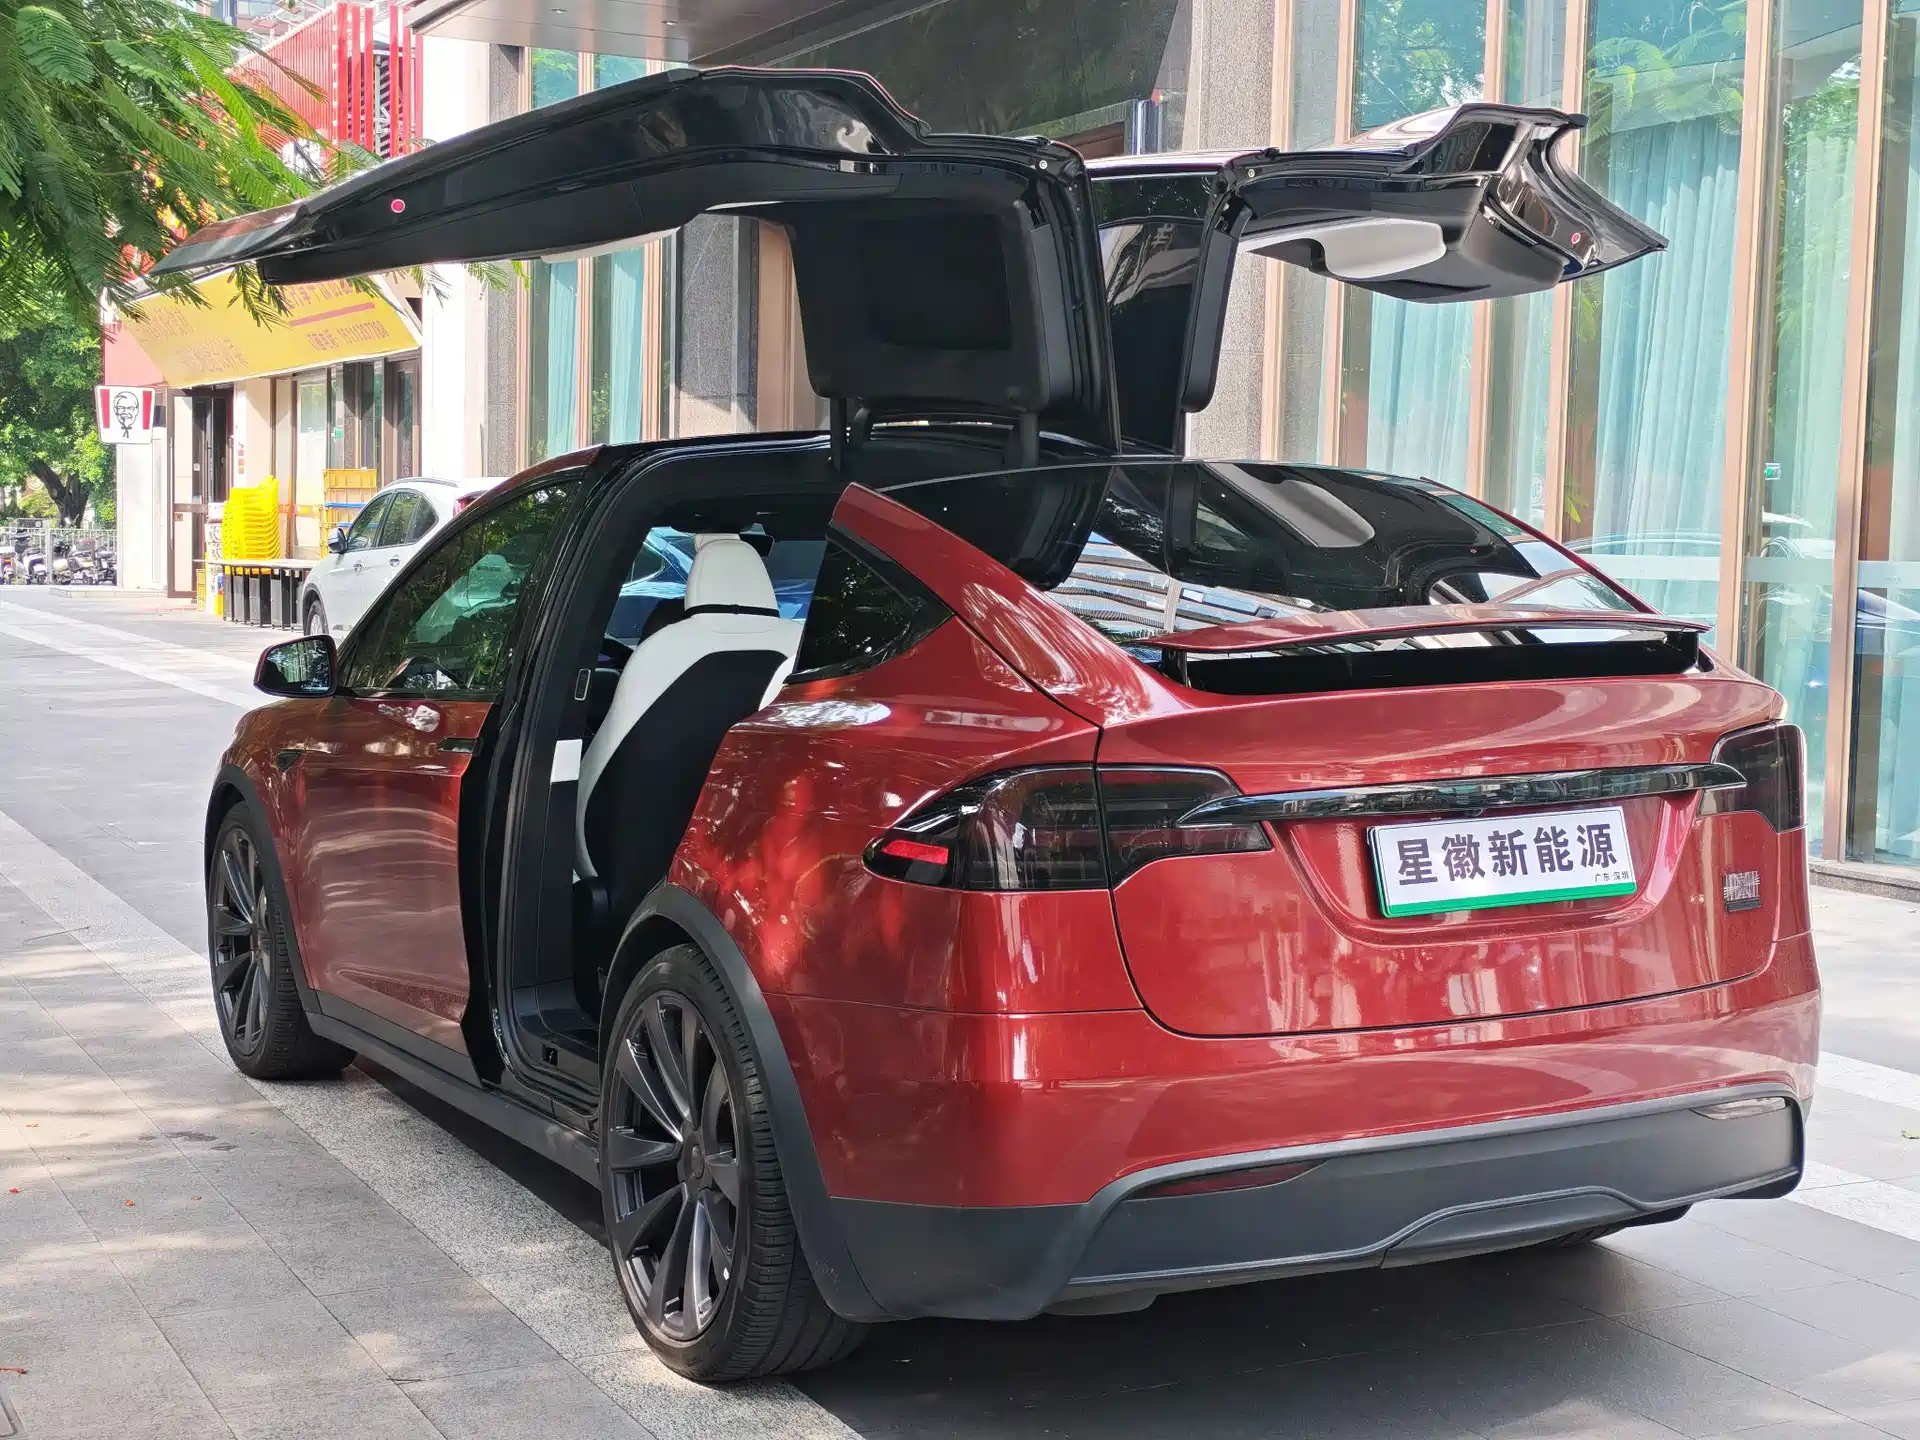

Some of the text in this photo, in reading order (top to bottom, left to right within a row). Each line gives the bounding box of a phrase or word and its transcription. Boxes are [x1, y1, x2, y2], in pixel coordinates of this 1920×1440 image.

[1396, 823, 1618, 886] 星徽新能源
